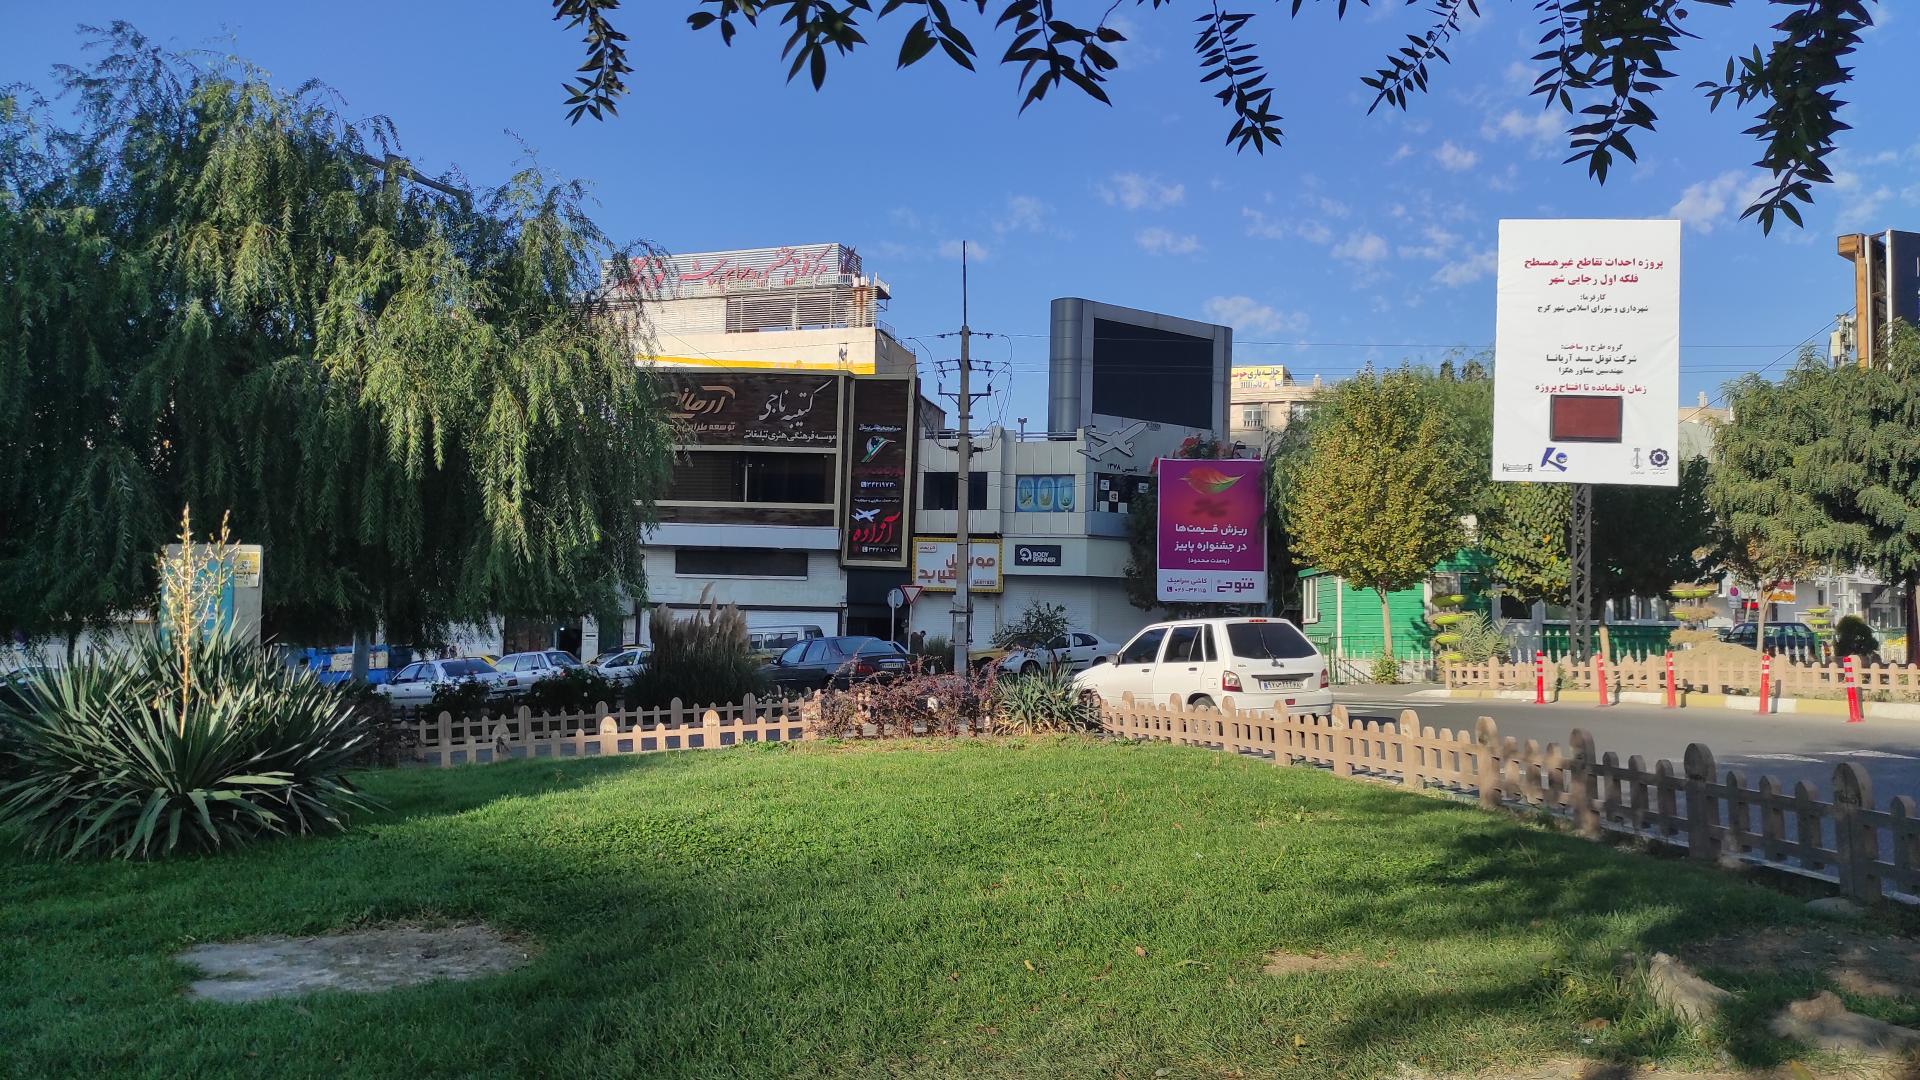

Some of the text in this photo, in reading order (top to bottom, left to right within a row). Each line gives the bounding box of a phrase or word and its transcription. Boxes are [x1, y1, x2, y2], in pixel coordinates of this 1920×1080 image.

[1576, 257, 1602, 270] تقاطع
[1604, 257, 1636, 267] احداث
[1638, 258, 1664, 270] پروژه
[1548, 275, 1566, 286] شهر
[1600, 274, 1617, 286] اول
[1619, 274, 1639, 284] فلکه
[1537, 304, 1552, 313] کرج
[1553, 304, 1565, 313] شهر
[1566, 304, 1590, 313] اسلامی
[1590, 304, 1613, 313] شورای
[1619, 304, 1649, 313] شهرداری
[1590, 343, 1605, 352] طرح
[1595, 354, 1613, 365] تونل
[1614, 354, 1637, 365] شرکت
[1575, 368, 1594, 376] مشاور
[1595, 368, 1624, 376] مهندسین
[1535, 384, 1558, 393] پروژه
[1583, 383, 1590, 391] تا
[1627, 384, 1647, 395] زمان
[758, 379, 833, 429] کتیبه ناجی
[768, 430, 787, 442] هنری
[787, 430, 815, 442] فرهنگی
[814, 432, 837, 441] موسسه
[852, 511, 901, 543] آزاده
[1221, 525, 1248, 536] ریزش
[1197, 541, 1235, 553] جشنواره
[1237, 543, 1248, 553] در
